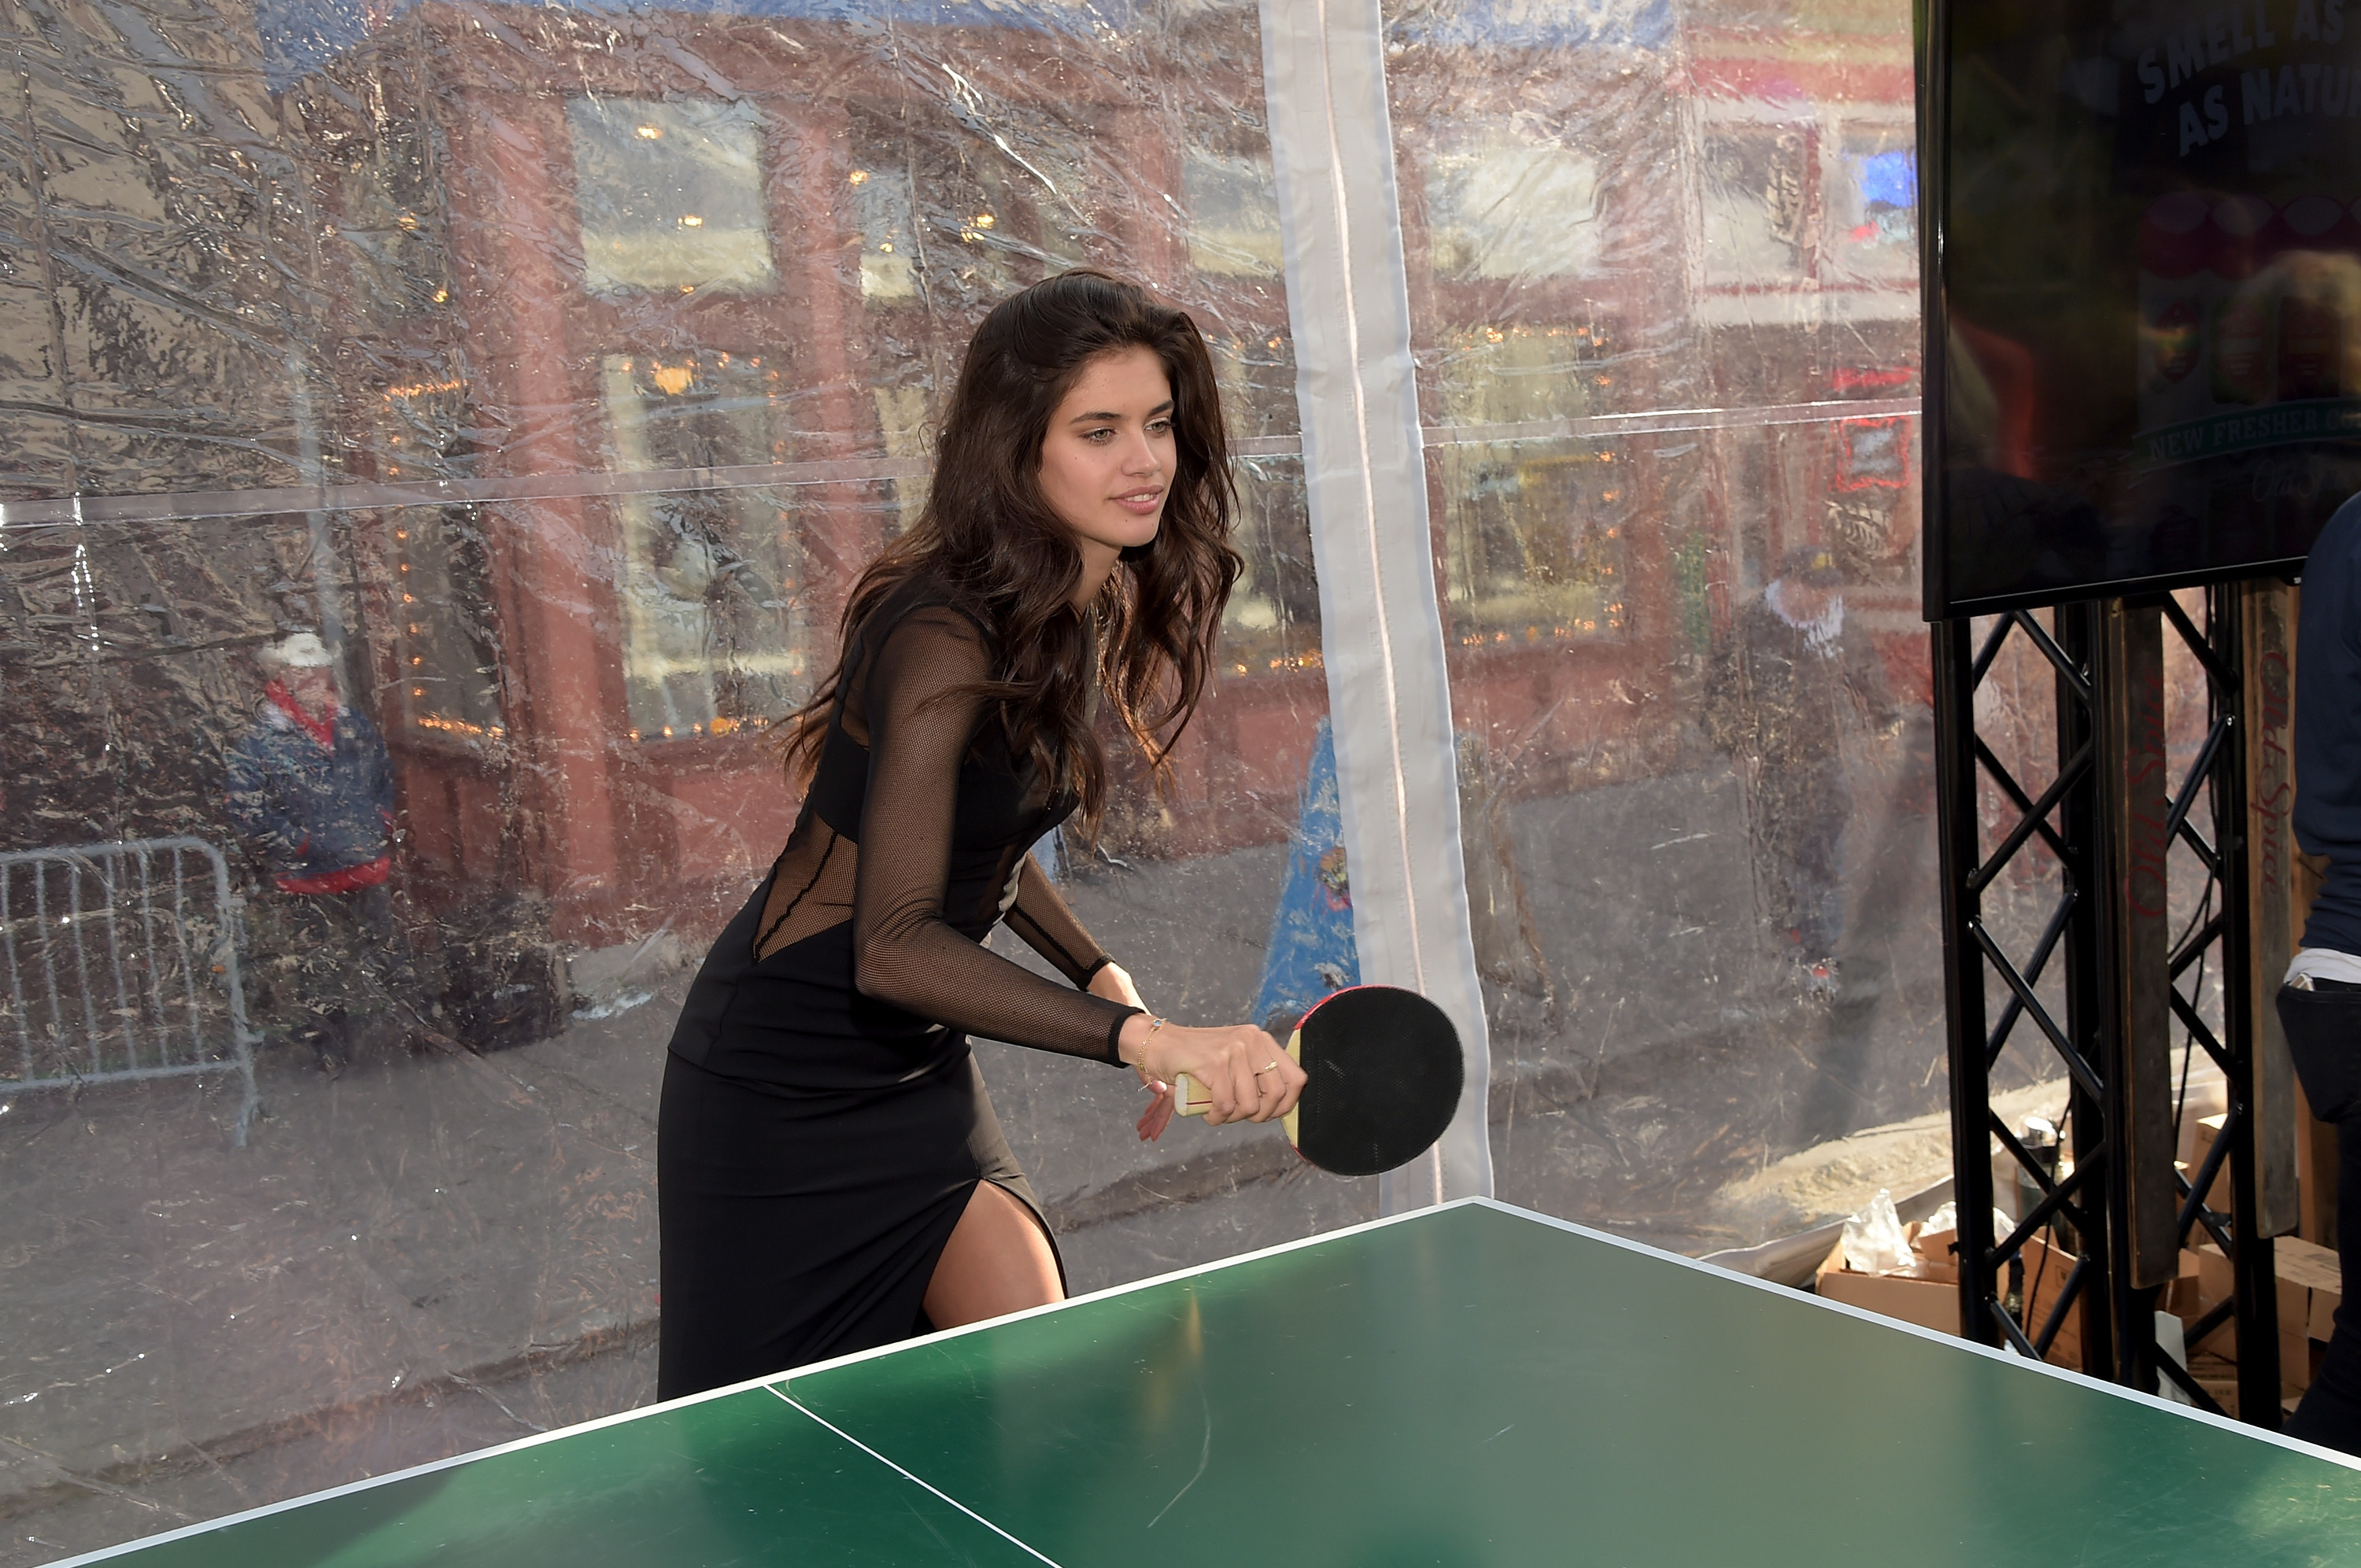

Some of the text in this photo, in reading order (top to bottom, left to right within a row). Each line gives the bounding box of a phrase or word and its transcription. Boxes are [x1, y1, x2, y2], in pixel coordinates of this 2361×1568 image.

[2137, 0, 2345, 105] SMELL AS
[2179, 84, 2229, 157] AS
[2149, 426, 2204, 462] NEW
[2212, 408, 2318, 446] FRESHER
[2260, 651, 2289, 756] Old
